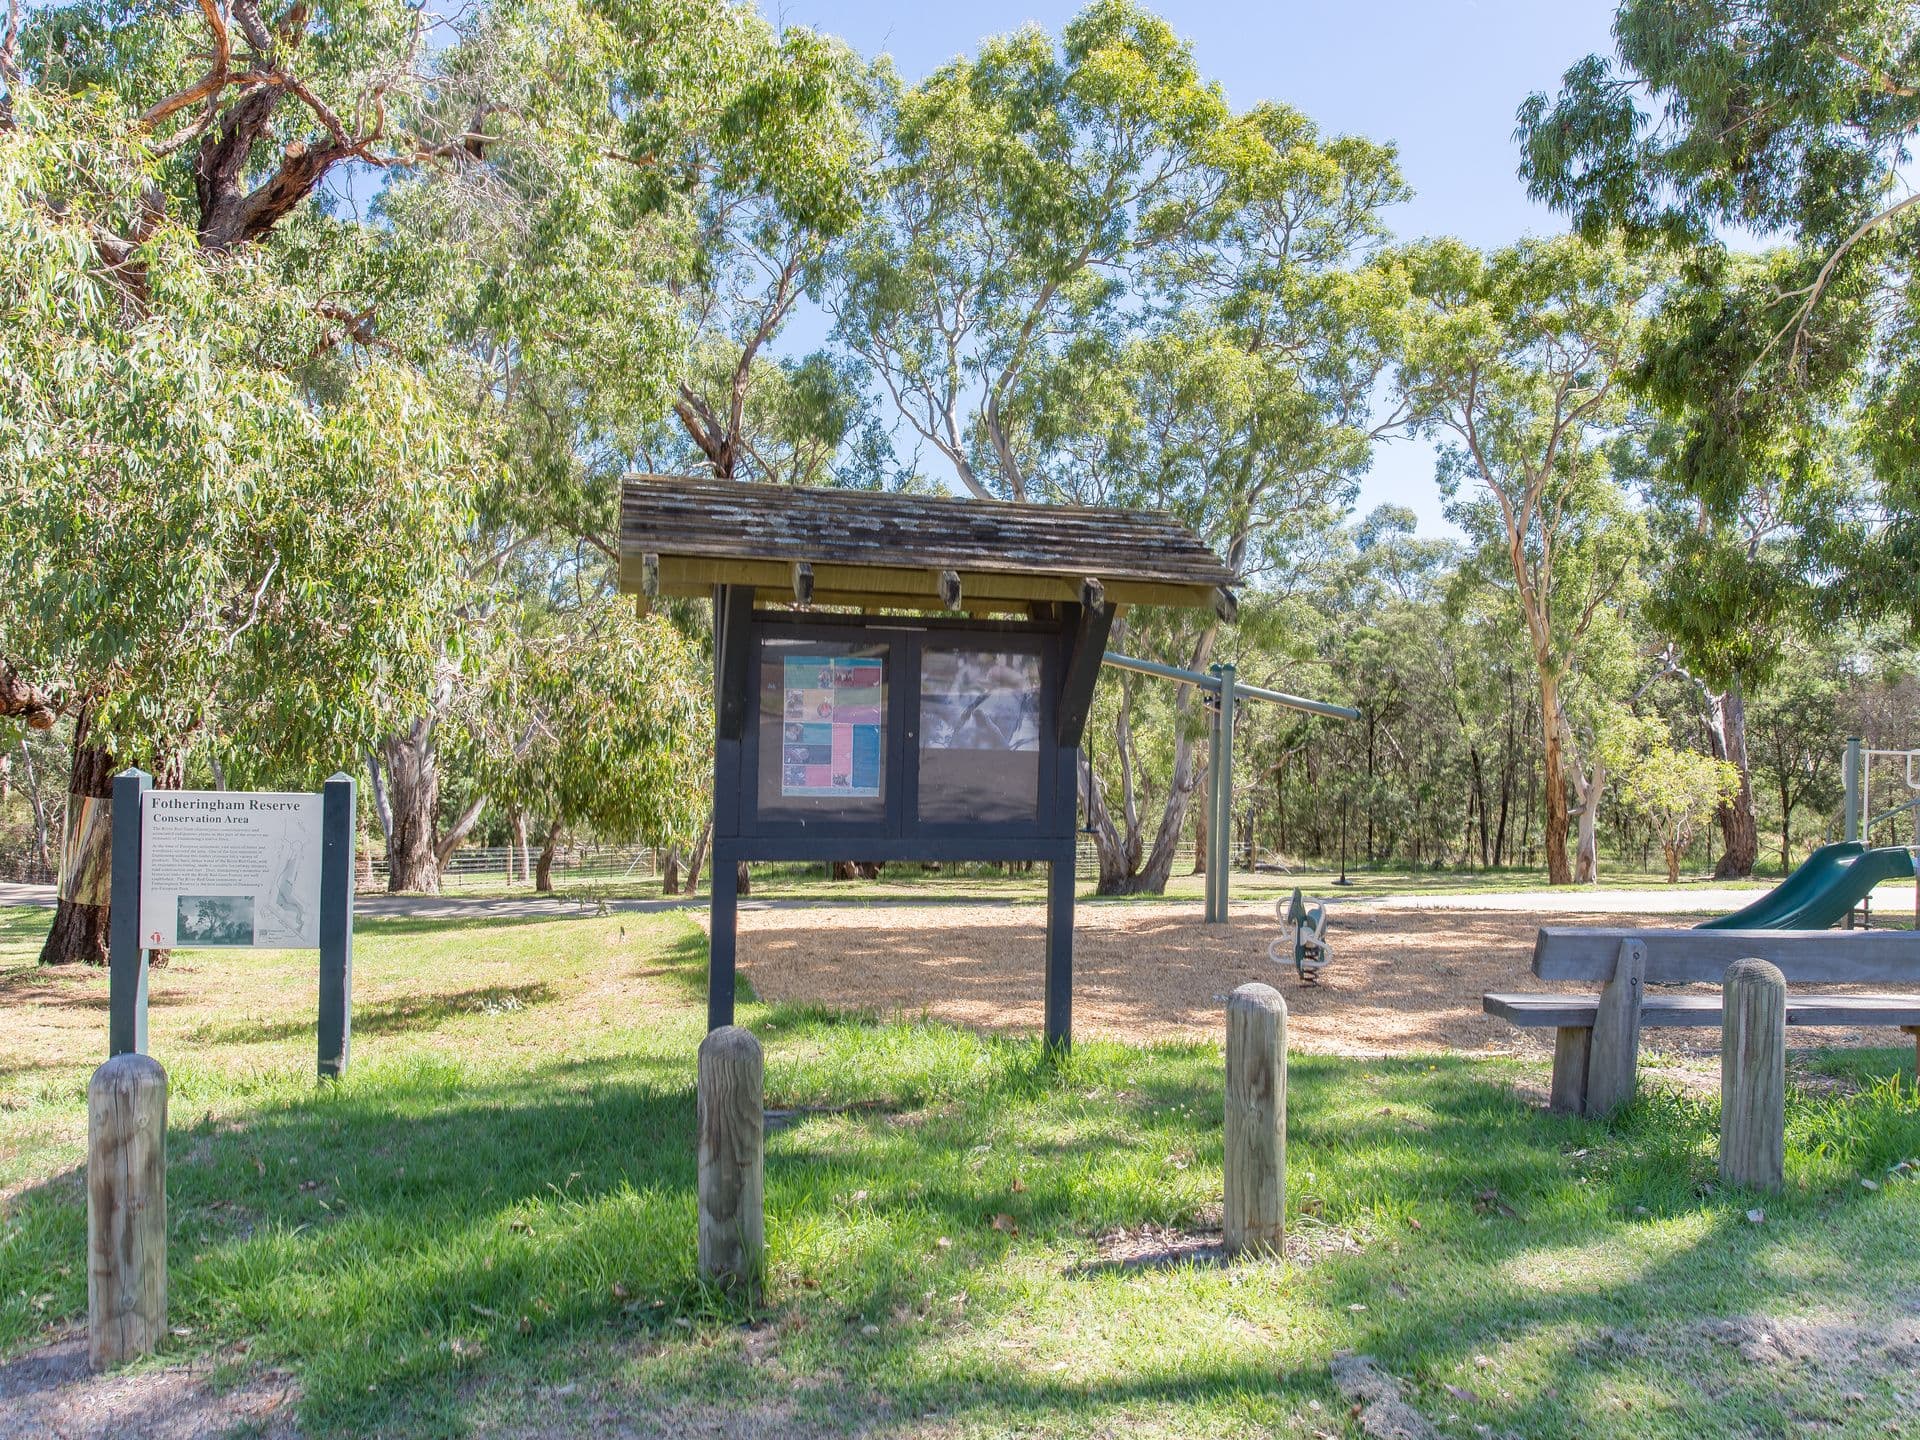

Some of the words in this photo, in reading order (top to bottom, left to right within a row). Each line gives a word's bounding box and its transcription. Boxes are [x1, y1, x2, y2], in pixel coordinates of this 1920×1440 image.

[152, 798, 245, 811] Fotheringham
[250, 799, 300, 811] Reserve
[153, 813, 222, 823] Conservation
[224, 815, 249, 824] Area
